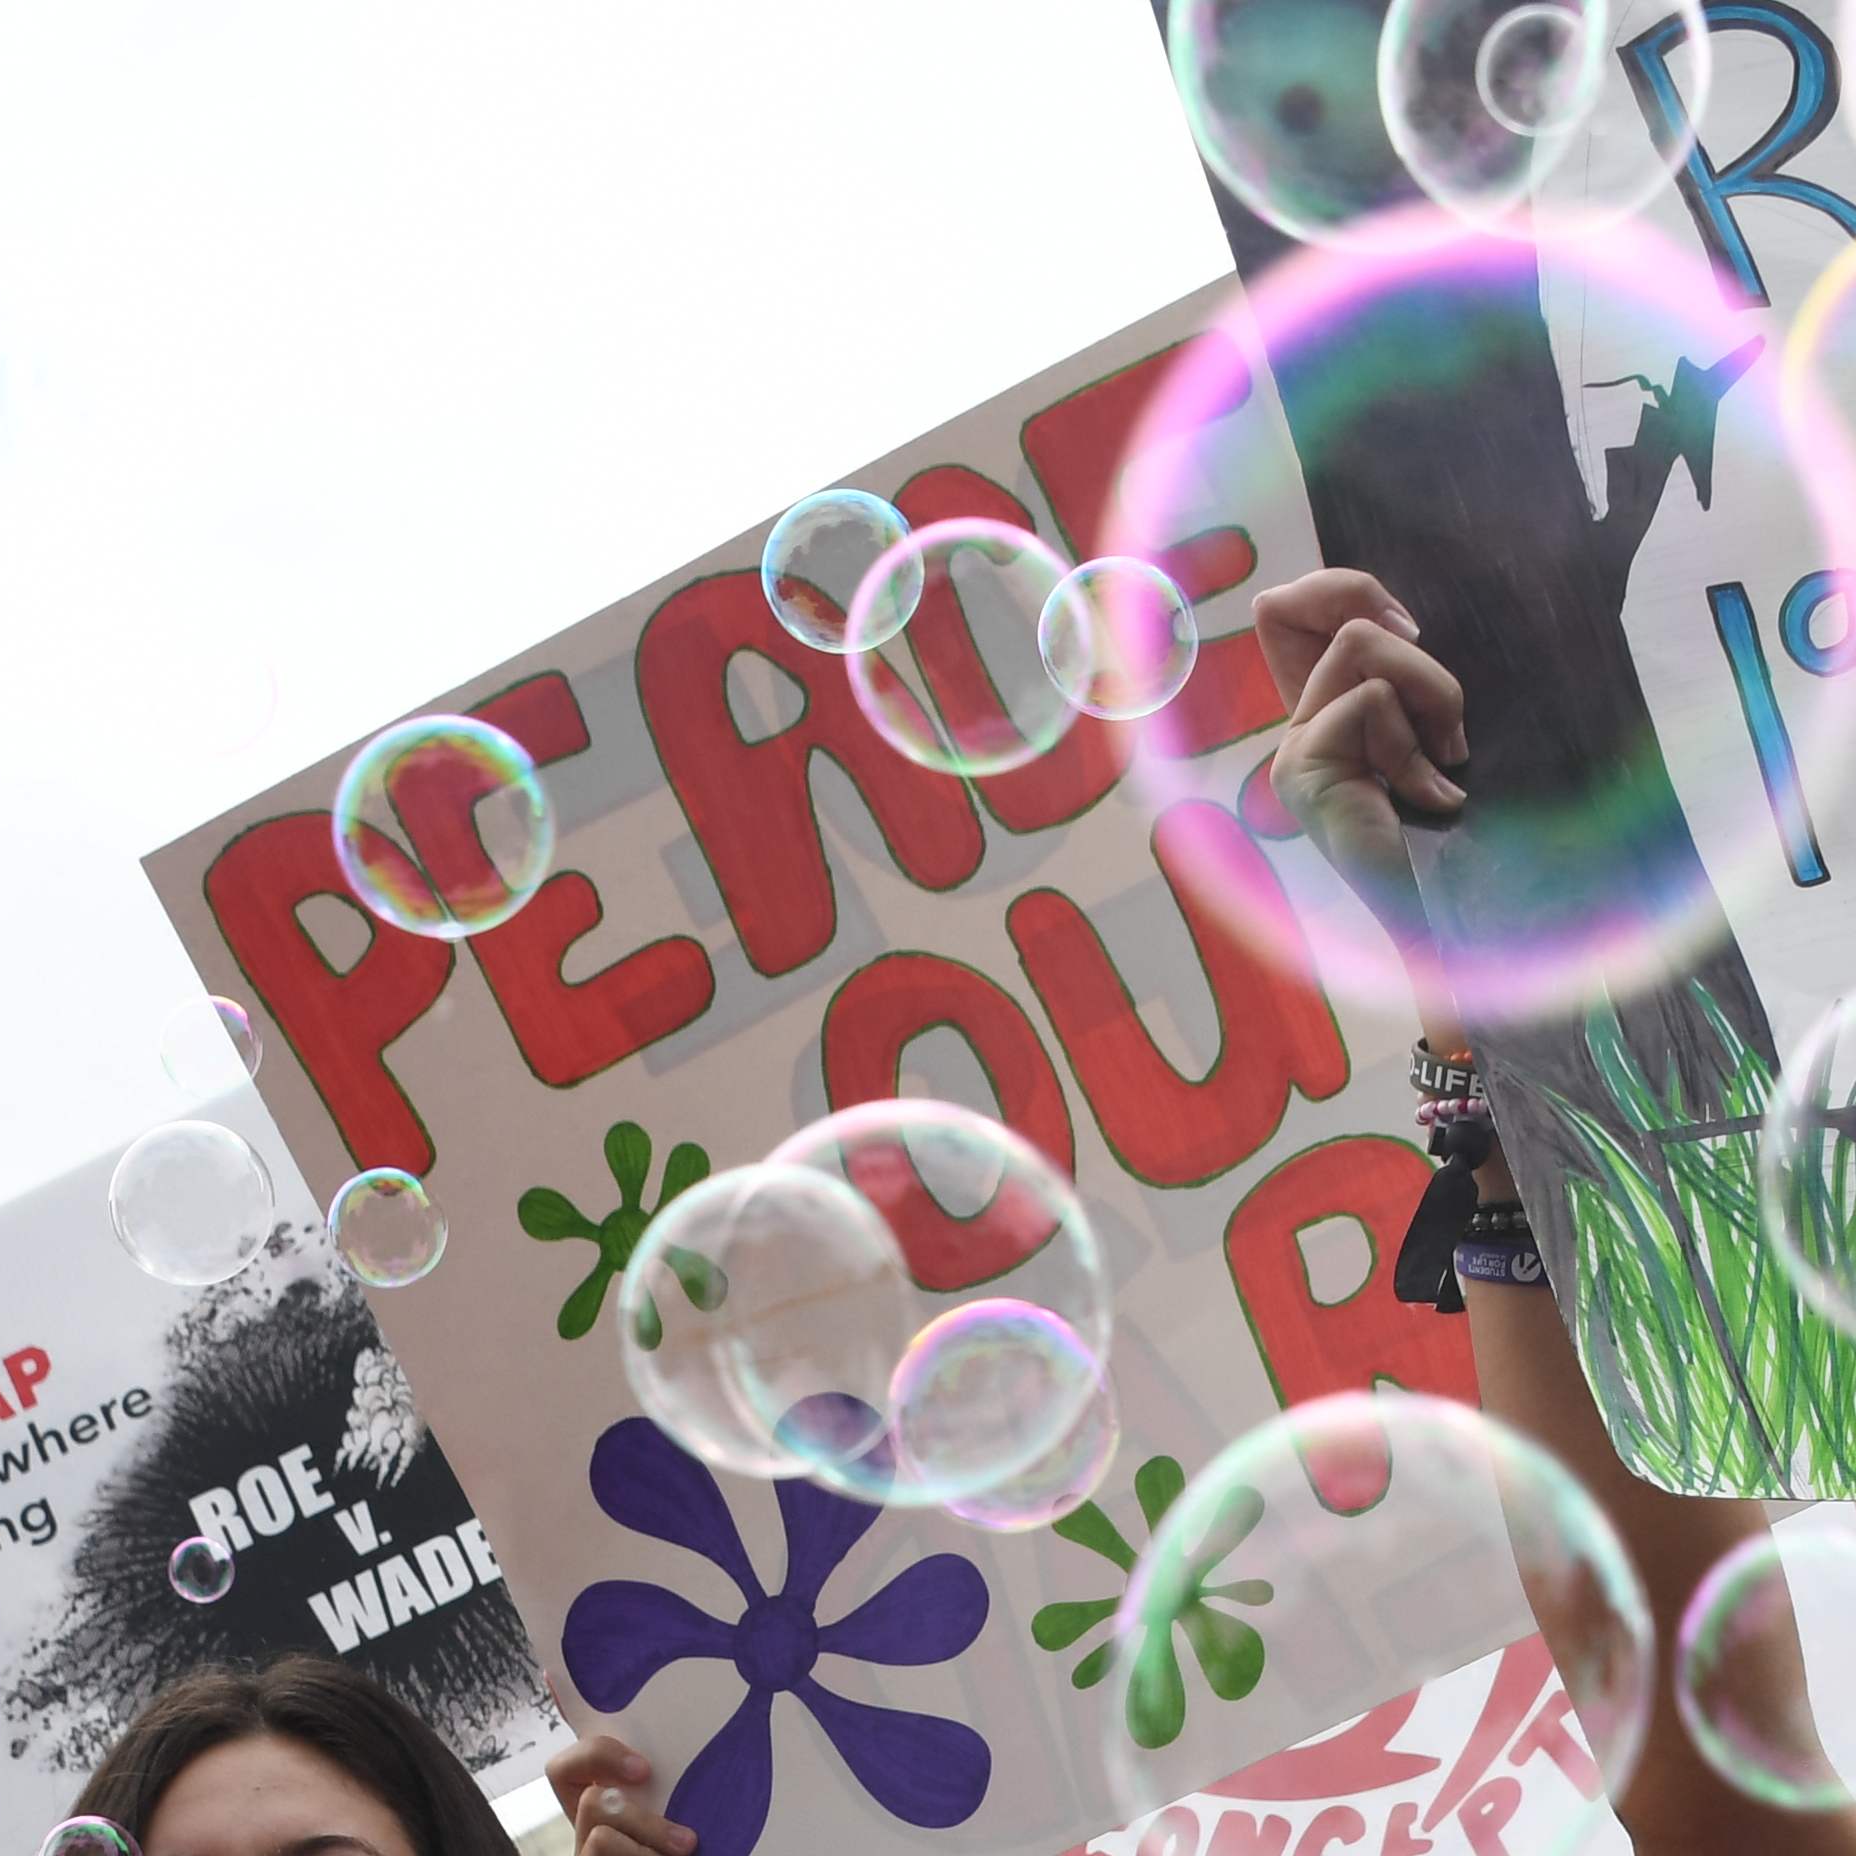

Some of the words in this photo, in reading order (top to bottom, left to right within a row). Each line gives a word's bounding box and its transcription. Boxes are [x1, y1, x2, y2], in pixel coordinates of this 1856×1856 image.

[203, 325, 1290, 1180] PEACE
[189, 1443, 335, 1562] ROE
[307, 1517, 502, 1655] WADE
